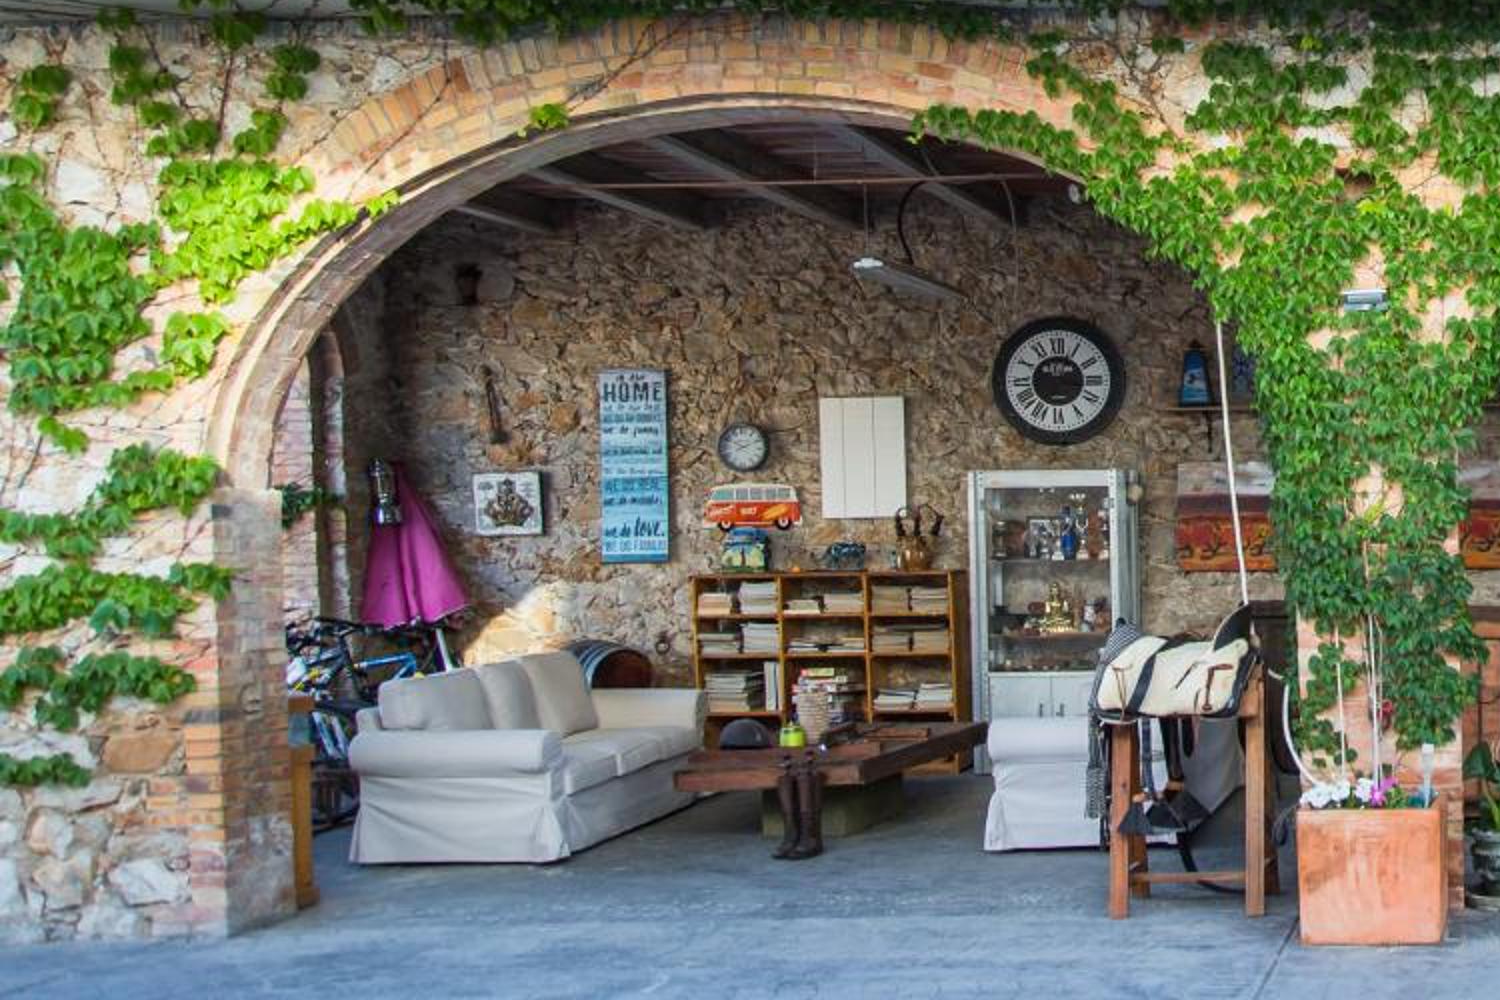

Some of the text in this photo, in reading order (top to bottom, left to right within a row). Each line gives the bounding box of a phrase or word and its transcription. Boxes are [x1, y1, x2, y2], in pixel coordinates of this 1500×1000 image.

[603, 381, 663, 403] HOME
[605, 525, 617, 538] we
[620, 522, 631, 538] do
